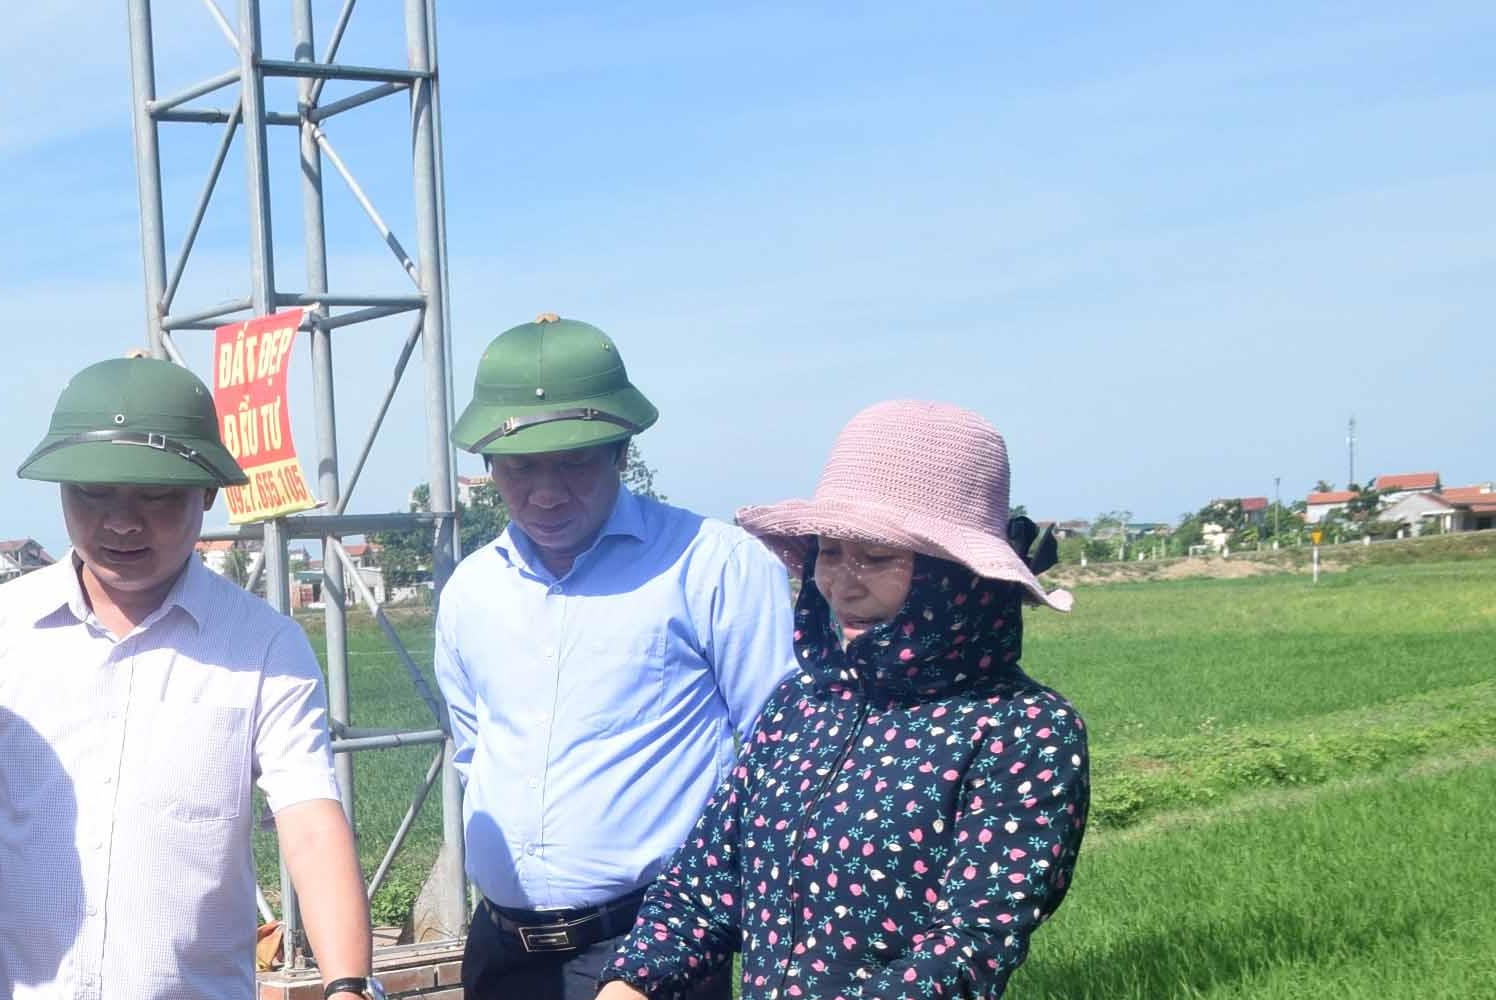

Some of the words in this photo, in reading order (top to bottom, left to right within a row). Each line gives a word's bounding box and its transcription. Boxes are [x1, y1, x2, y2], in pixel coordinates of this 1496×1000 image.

[219, 321, 257, 388] ĐẤT
[258, 327, 294, 386] ĐẸP
[260, 396, 281, 451] TƯ
